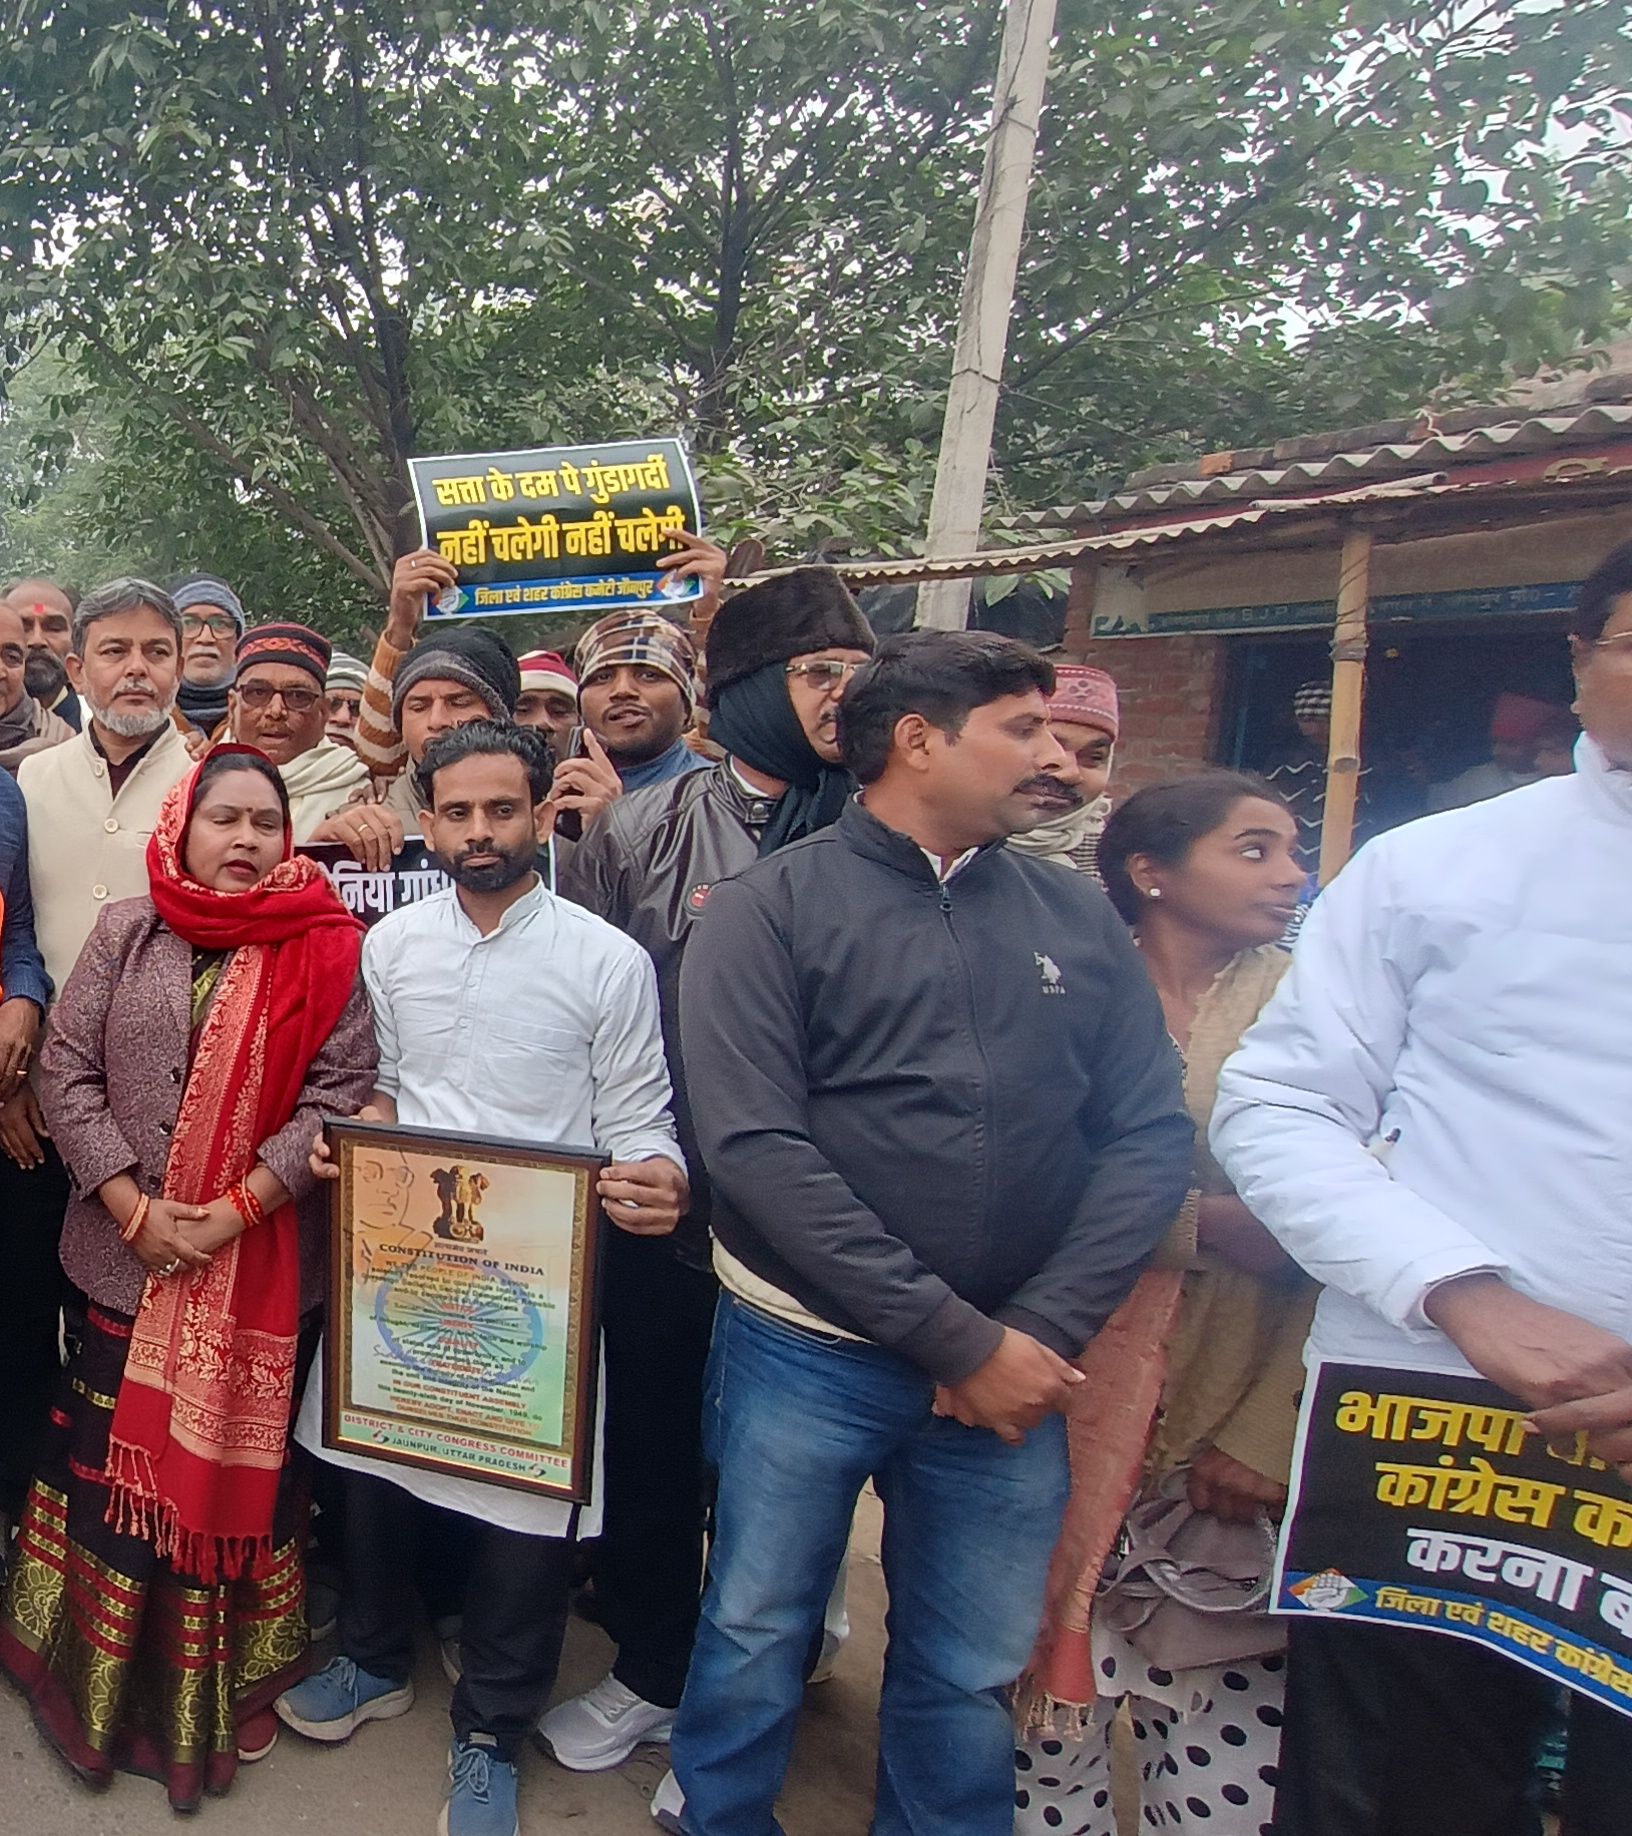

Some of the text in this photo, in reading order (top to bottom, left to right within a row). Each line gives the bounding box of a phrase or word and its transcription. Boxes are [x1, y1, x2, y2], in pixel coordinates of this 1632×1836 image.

[432, 453, 670, 505] सत्ता के दम पे गुंडागर्दी
[436, 505, 686, 565] नहीं चलेगी नहीं चलेगी
[475, 587, 504, 605] जिला
[522, 587, 549, 602] शहर
[379, 1243, 544, 1276] CONSTITUTION OF INDIA
[344, 1414, 568, 1469] DISTRICT & CITY CONGRESS COMMITTEE
[1335, 1390, 1528, 1456] भाजपा
[442, 1446, 477, 1461] UTTAR
[478, 1456, 526, 1472] PRADESH
[1375, 1454, 1566, 1529] कांग्रेस
[1406, 1527, 1594, 1612] करना
[1375, 1586, 1442, 1617] जिला
[1444, 1602, 1485, 1626] एवं
[1487, 1610, 1555, 1655] शहर
